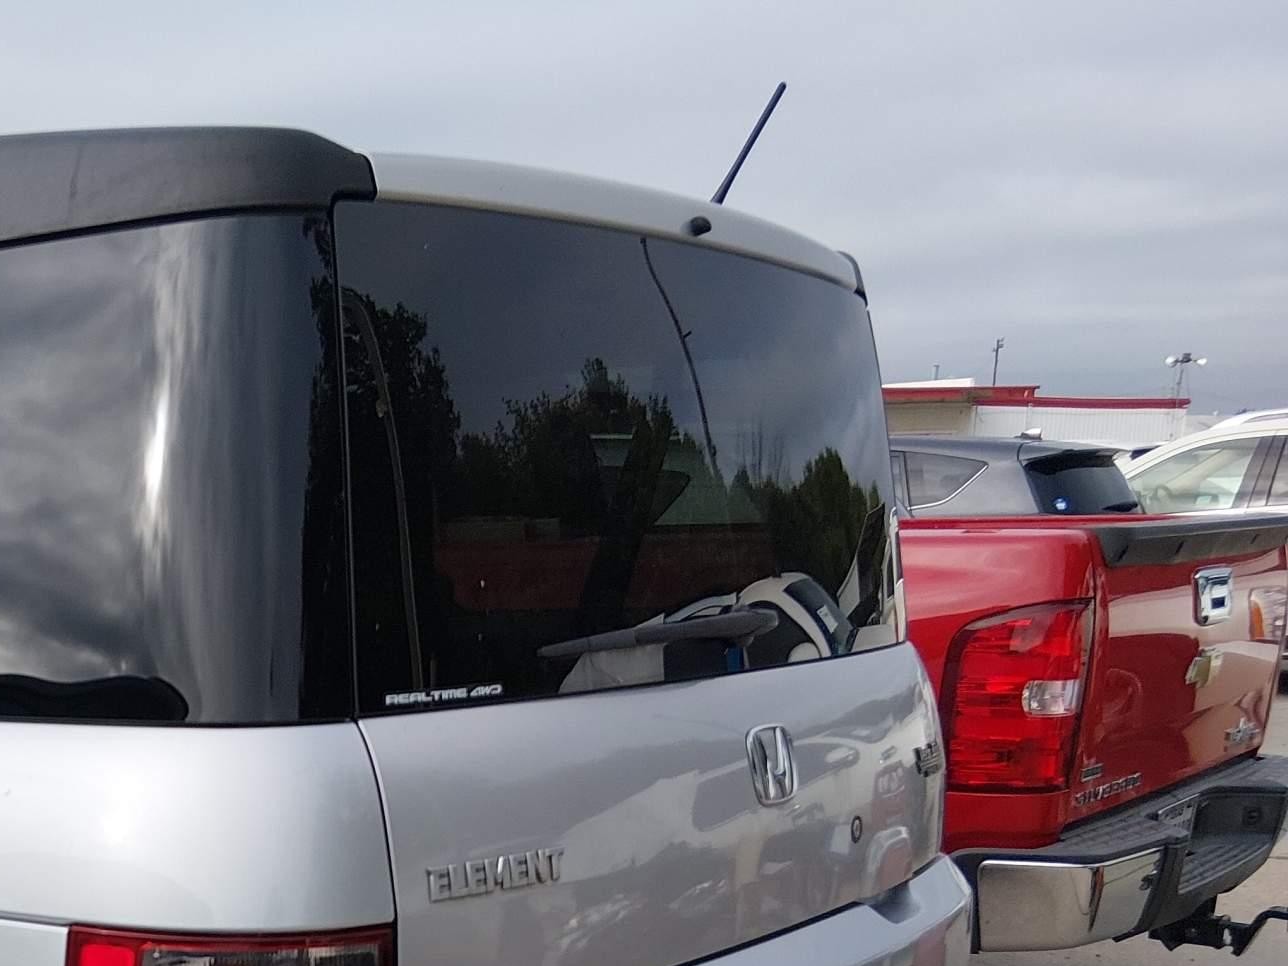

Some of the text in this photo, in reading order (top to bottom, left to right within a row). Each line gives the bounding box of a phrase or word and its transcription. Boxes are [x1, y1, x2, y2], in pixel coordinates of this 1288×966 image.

[384, 683, 504, 706] REALTIME 4WD
[425, 848, 565, 904] ELEMENT
